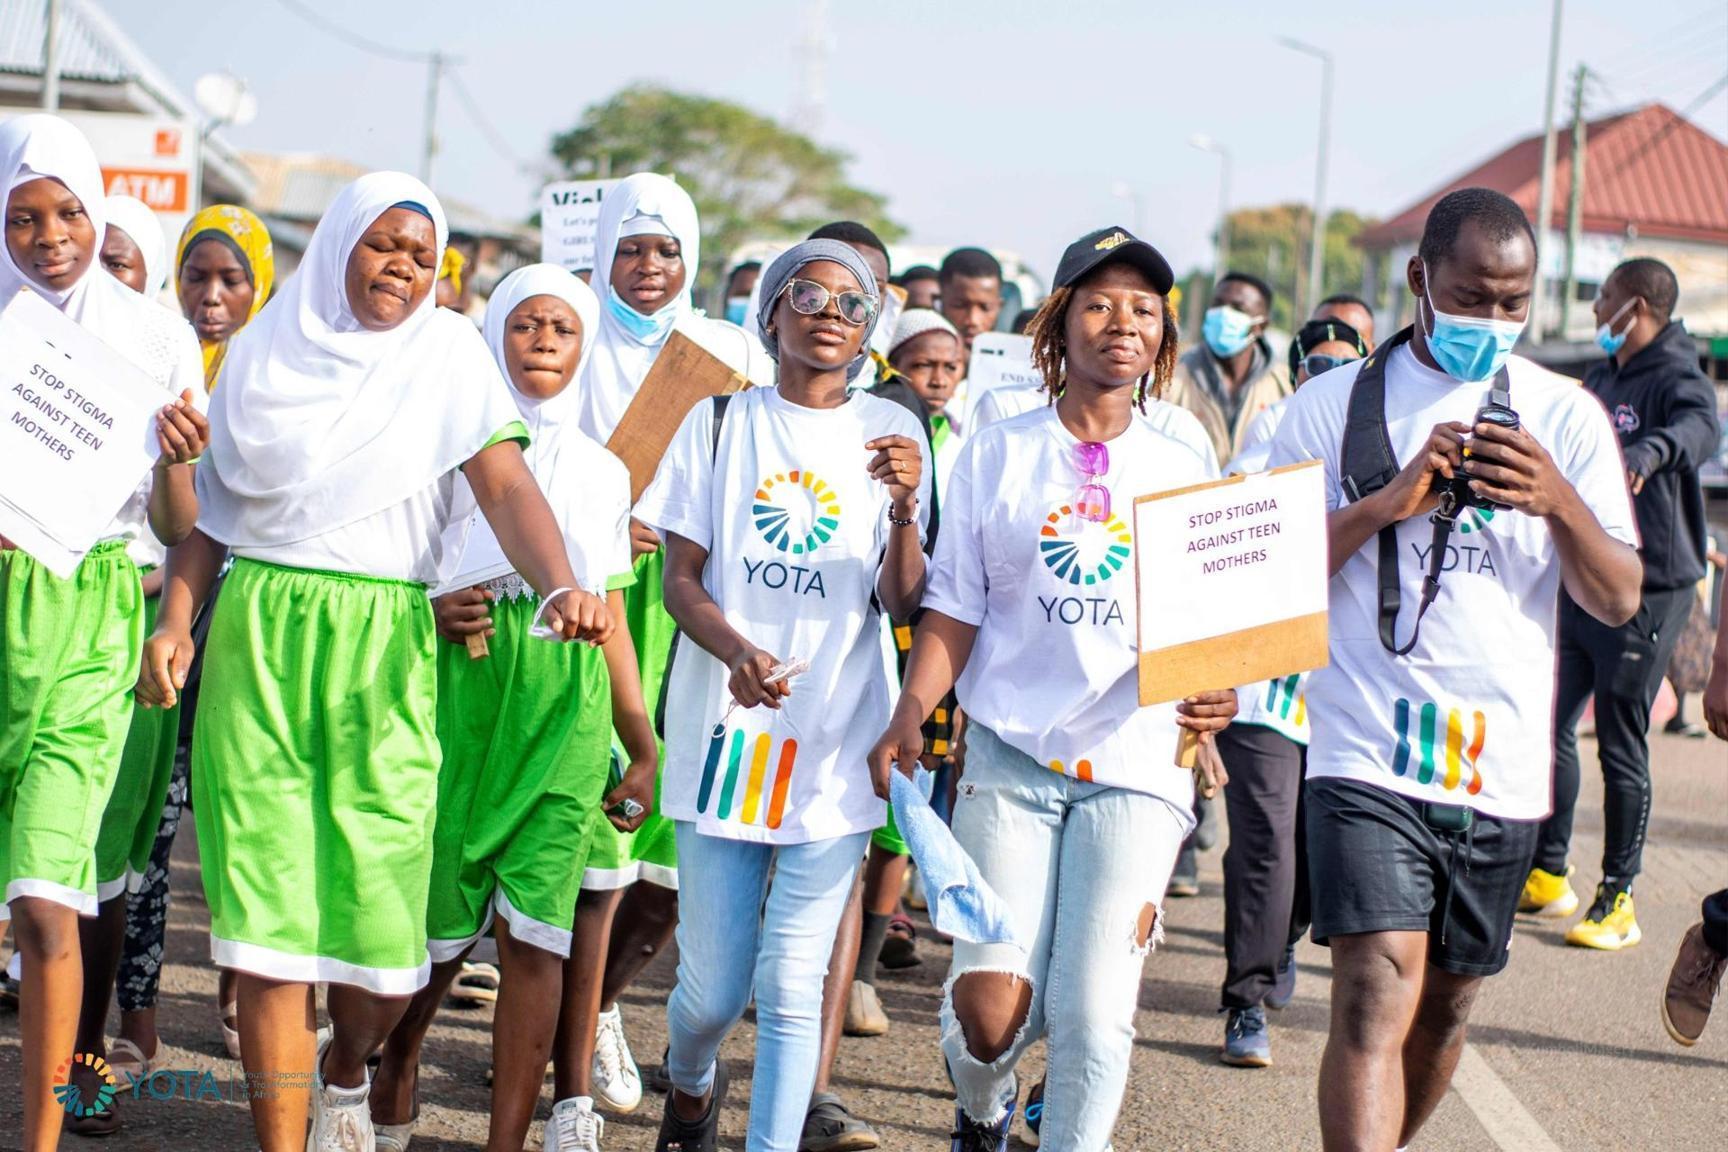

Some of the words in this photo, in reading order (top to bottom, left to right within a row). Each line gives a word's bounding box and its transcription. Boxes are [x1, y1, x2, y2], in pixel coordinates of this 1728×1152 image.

[109, 173, 176, 206] ATM
[29, 364, 65, 391] STOP
[63, 388, 114, 430] STIGMA
[12, 383, 71, 426] AGAINST
[70, 421, 104, 451] TEEN
[11, 411, 75, 461] MOTHERS
[1189, 510, 1223, 529] STOP
[1226, 498, 1278, 520] STIGMA
[1187, 529, 1245, 553] AGAINST
[1248, 522, 1281, 540] TEEN
[1203, 549, 1267, 574] MOTHERS
[1411, 542, 1496, 577] YOTA
[743, 556, 826, 598] YOTA
[1038, 595, 1124, 626] YOTA
